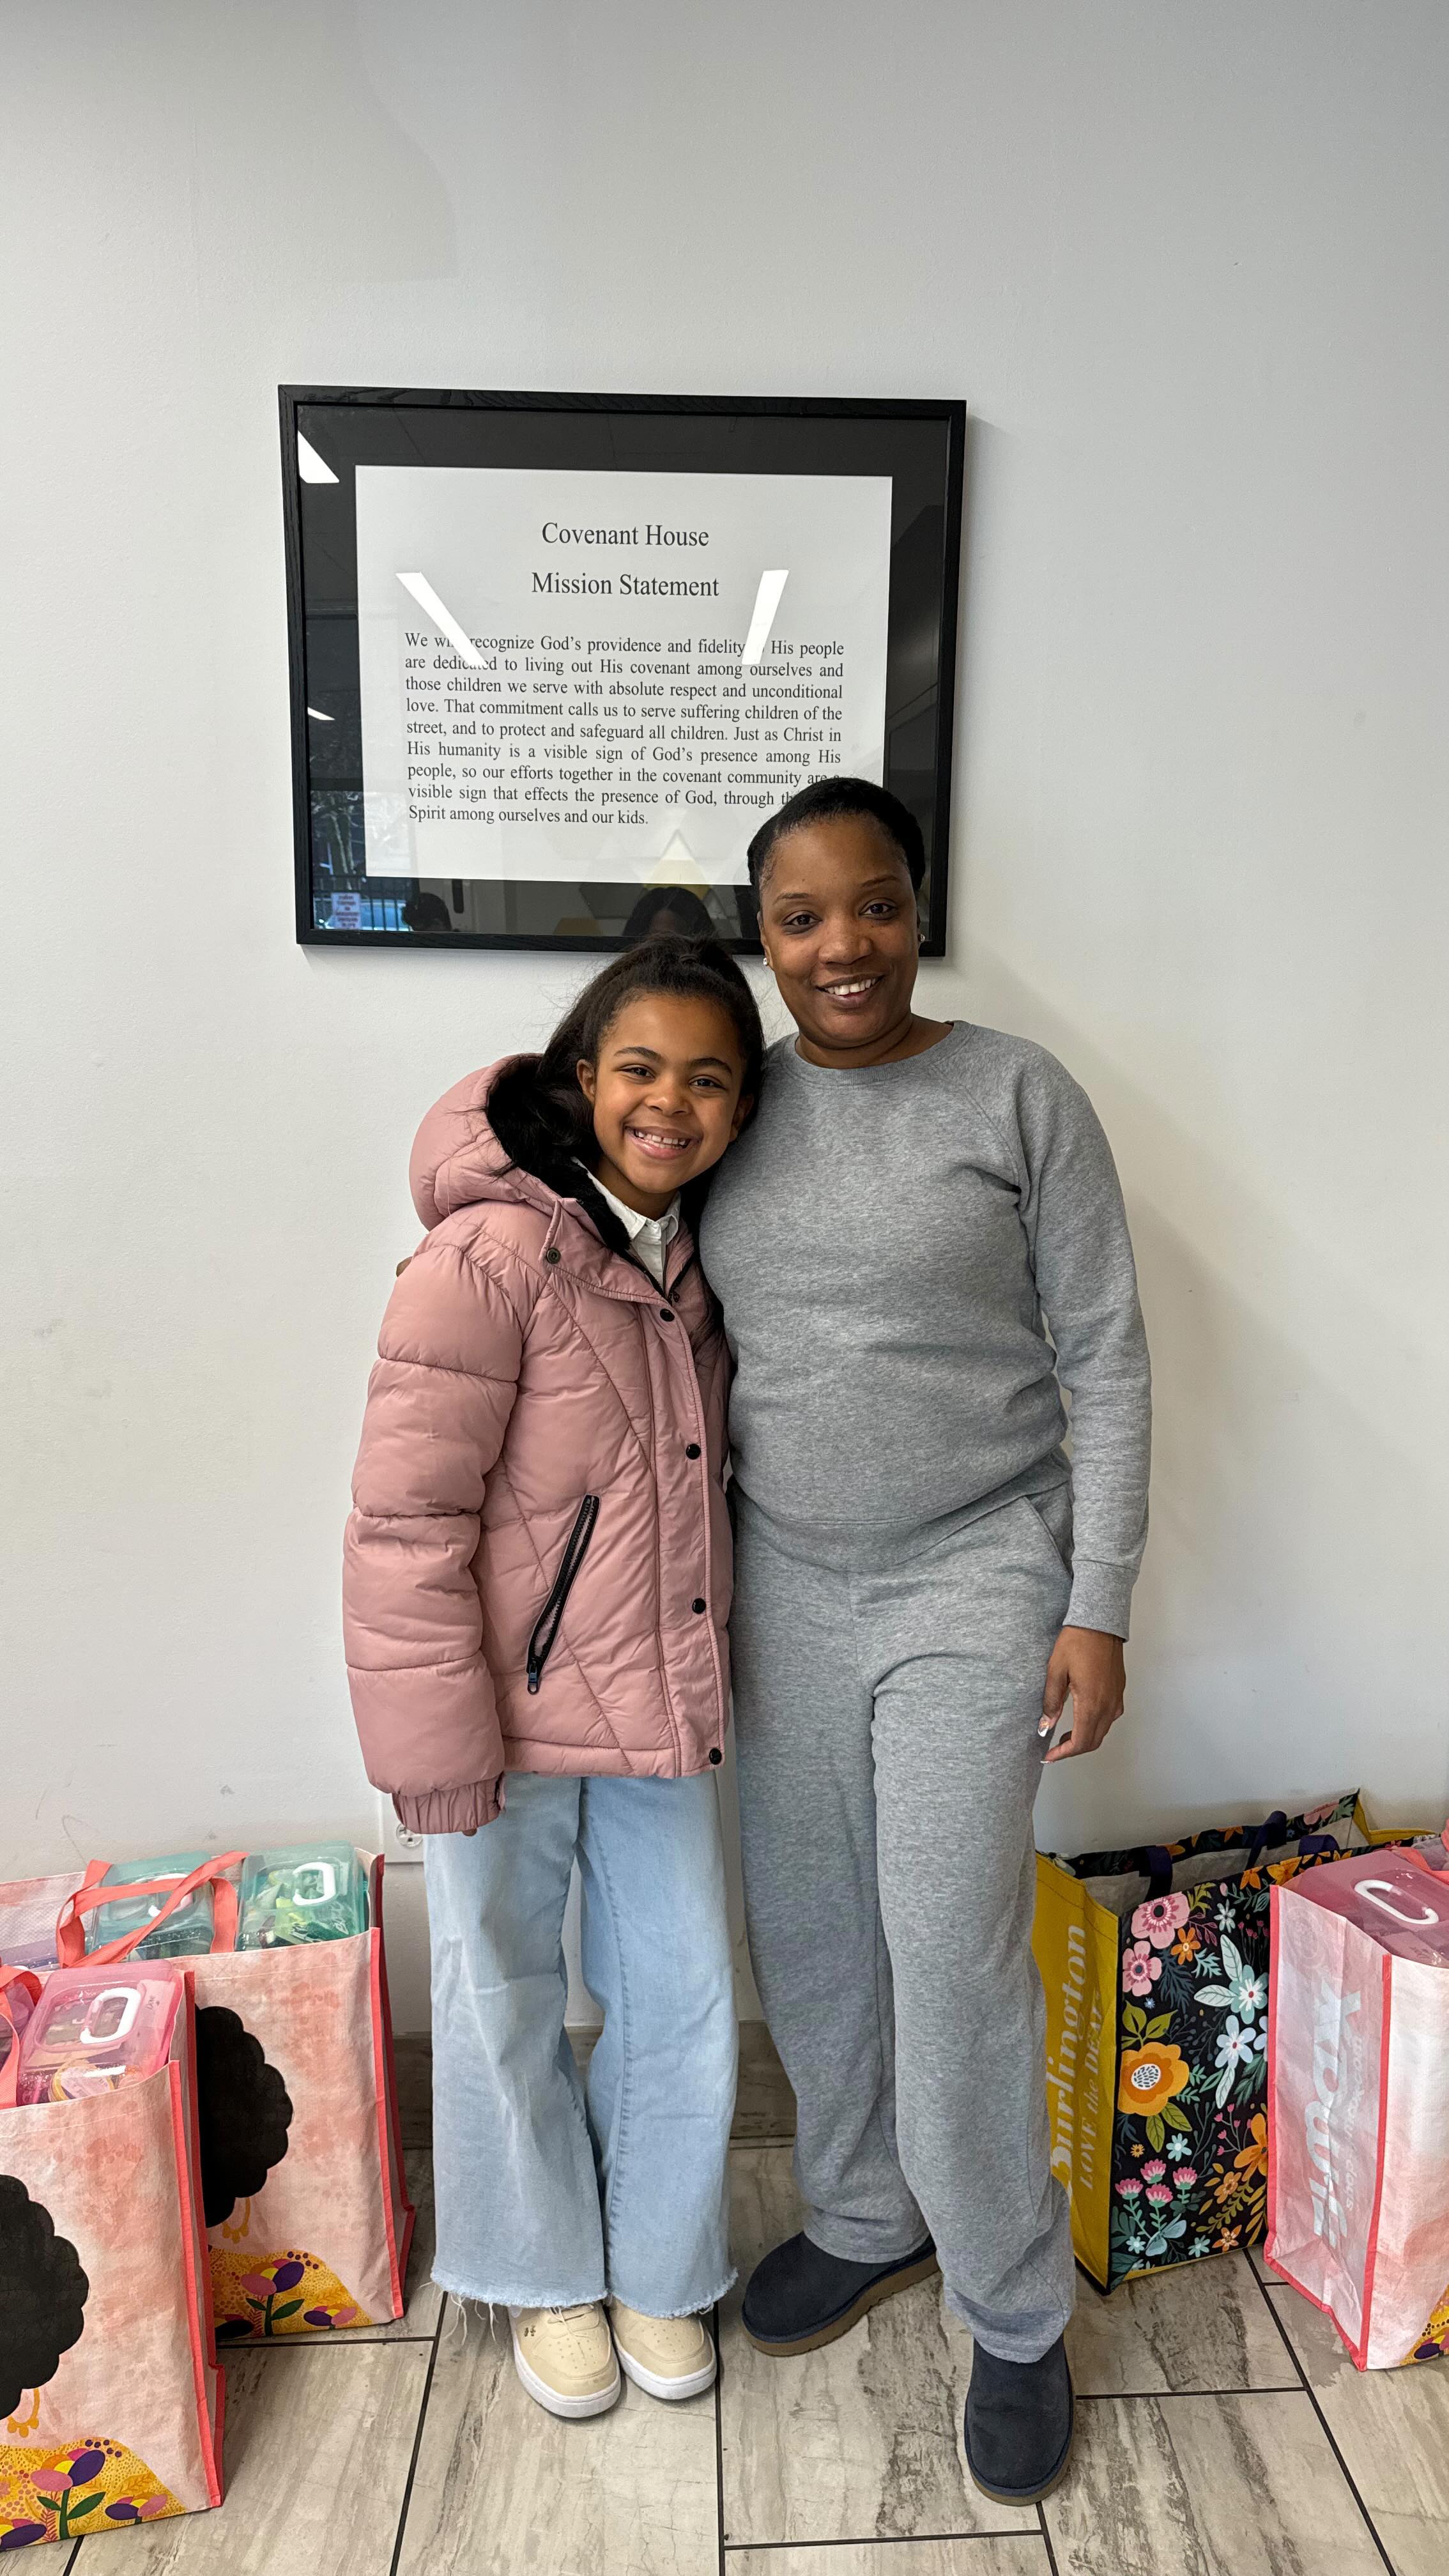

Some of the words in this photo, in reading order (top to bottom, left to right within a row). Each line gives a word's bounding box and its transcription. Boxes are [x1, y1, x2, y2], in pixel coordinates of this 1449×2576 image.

[542, 522, 639, 545] Covenant
[644, 525, 709, 547] House
[531, 572, 613, 595] Mission
[620, 574, 719, 597] Statement
[404, 632, 428, 647] We
[469, 634, 535, 653] recognize
[586, 636, 662, 655] providence
[667, 638, 692, 653] and
[698, 638, 746, 657] fidelity
[770, 640, 794, 655] His
[799, 640, 844, 659] people
[405, 658, 425, 669] are
[504, 658, 518, 671] to
[525, 656, 564, 676] living
[571, 660, 593, 673] out
[599, 659, 623, 674] His
[630, 662, 691, 675] covenant
[697, 664, 743, 680] among
[749, 661, 813, 677] ourselves
[819, 663, 844, 677] and
[405, 675, 441, 691] those
[447, 677, 502, 693] children
[507, 682, 527, 693] we
[533, 683, 568, 694] serve
[573, 679, 604, 694] with
[609, 680, 664, 696] absolute
[670, 684, 717, 701] respect
[722, 682, 747, 698] and
[751, 684, 843, 699] unconditional
[406, 697, 439, 712] love.
[443, 698, 475, 714] That
[479, 700, 564, 716] commitment
[568, 702, 599, 716] calls
[602, 706, 618, 717] us
[623, 705, 636, 717] to
[641, 707, 676, 718] serve
[680, 703, 740, 723] suffering
[744, 705, 799, 720] children
[803, 705, 820, 720] of
[822, 705, 843, 721] the
[406, 721, 447, 737] street,
[452, 720, 477, 735] and
[481, 723, 494, 735] to
[499, 723, 546, 740] protect
[551, 723, 576, 737] and
[579, 723, 645, 742] safeguard
[648, 724, 666, 739] all
[670, 725, 728, 740] children.
[733, 726, 760, 741] Just
[764, 730, 778, 741] as
[783, 726, 824, 742] Christ
[828, 727, 841, 742] in
[407, 740, 431, 756] His
[438, 741, 502, 761] humanity
[509, 742, 520, 758] is
[528, 747, 536, 758] a
[543, 744, 588, 759] visible
[595, 745, 624, 763] sign
[631, 746, 647, 760] of
[700, 751, 758, 765] presence
[765, 752, 811, 767] among
[818, 749, 841, 763] His
[407, 762, 456, 781] people,
[462, 767, 477, 778] so
[482, 768, 505, 779] our
[510, 764, 553, 780] efforts
[558, 766, 613, 784] together
[618, 767, 632, 781] in
[636, 767, 657, 782] the
[663, 770, 722, 783] covenant
[727, 770, 802, 788] community
[408, 783, 453, 799] visible
[459, 785, 487, 803] sign
[493, 785, 519, 800] that
[525, 786, 569, 802] effects
[574, 787, 595, 802] the
[601, 792, 659, 806] presence
[665, 789, 681, 804] of
[685, 790, 717, 807] God,
[723, 790, 774, 809] through
[781, 791, 793, 805] th
[409, 804, 446, 823] Spirit
[449, 809, 495, 825] among
[498, 808, 560, 823] ourselves
[564, 809, 588, 823] and
[592, 813, 615, 824] our
[617, 809, 648, 825] kids.
[1084, 2079, 1100, 2115] the
[1080, 2116, 1097, 2190] LOVE
